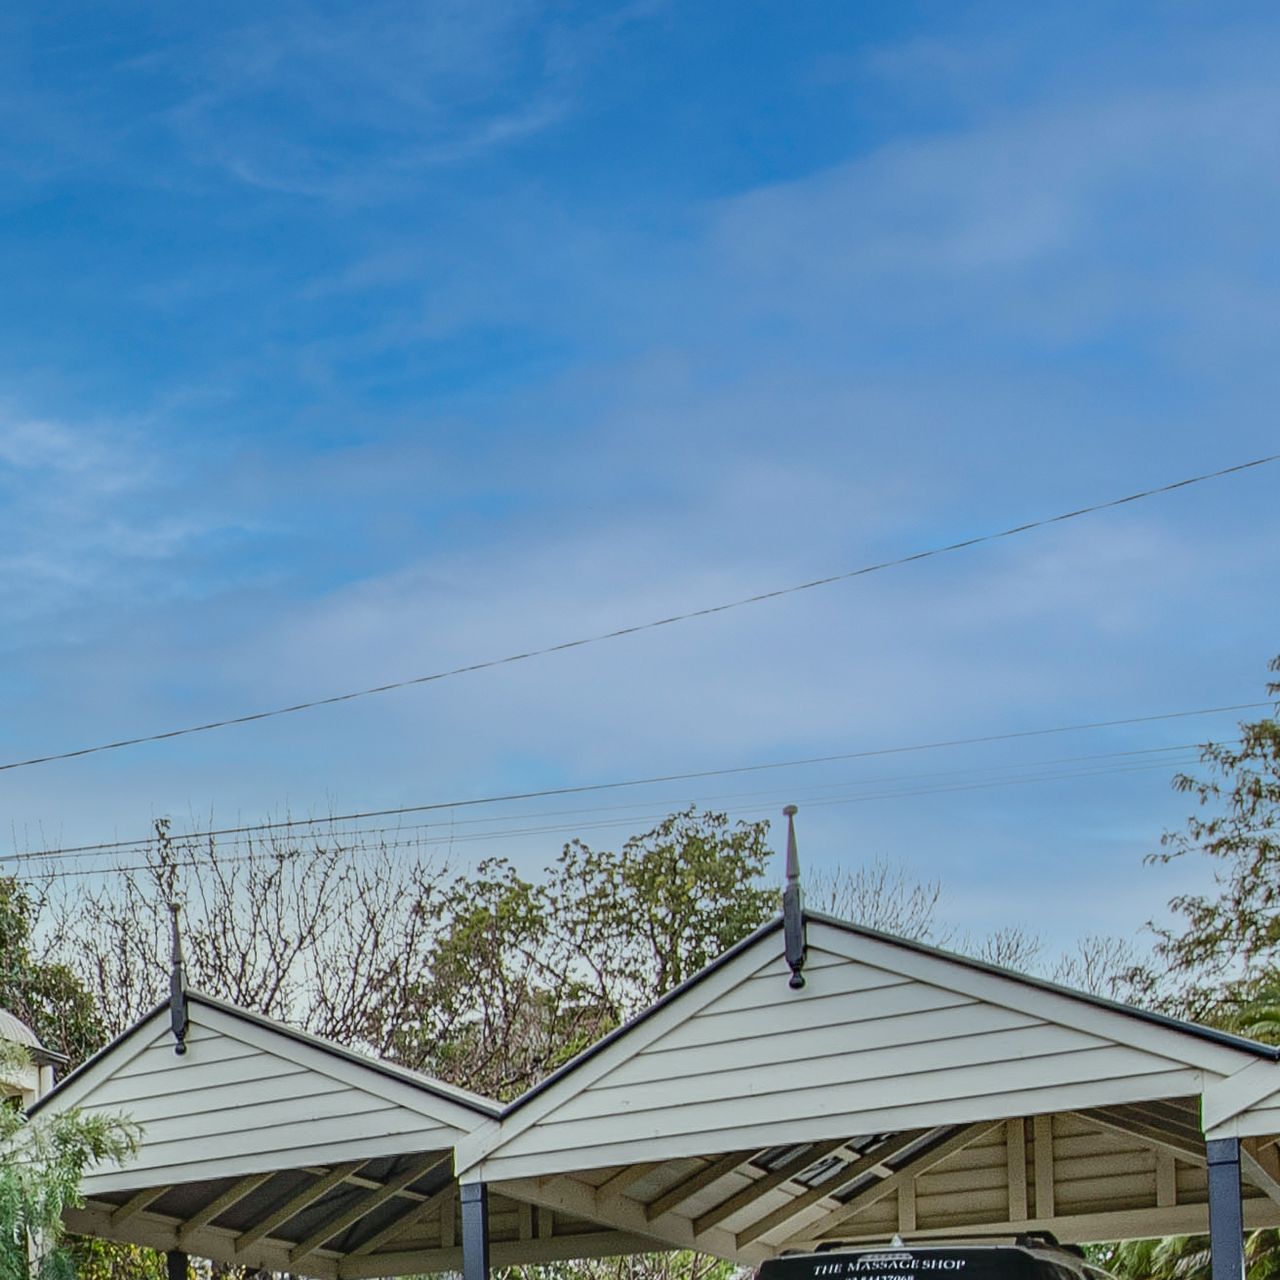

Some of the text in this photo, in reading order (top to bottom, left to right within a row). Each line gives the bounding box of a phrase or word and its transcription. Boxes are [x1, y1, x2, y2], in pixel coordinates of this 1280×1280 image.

[814, 1259, 966, 1275] THE MASSAGE SHOP
